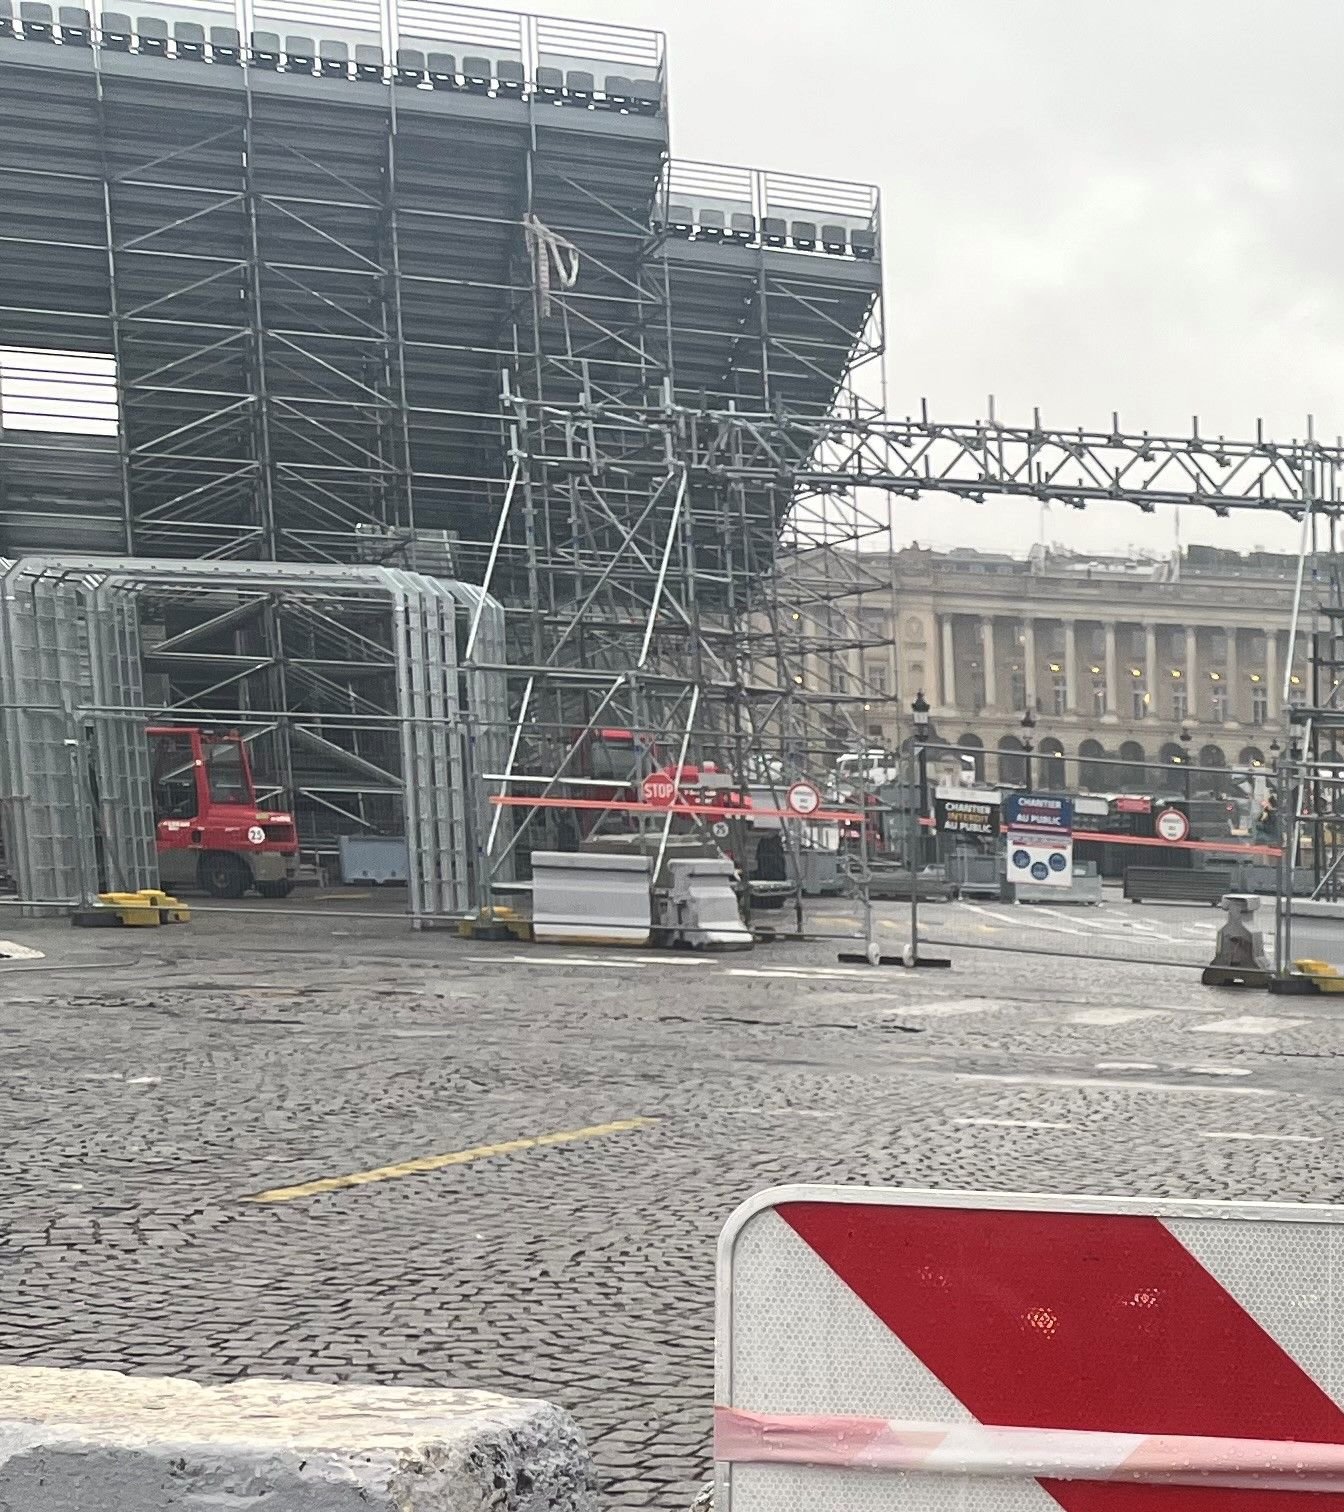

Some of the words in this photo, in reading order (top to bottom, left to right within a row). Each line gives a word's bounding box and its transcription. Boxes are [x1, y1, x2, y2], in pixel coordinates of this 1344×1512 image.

[643, 782, 674, 799] STOP
[945, 802, 991, 814] CHANTIER
[1016, 813, 1029, 822] AU
[1030, 814, 1061, 825] PUBLIC
[944, 821, 958, 830] AU
[960, 822, 993, 833] PUBLIC
